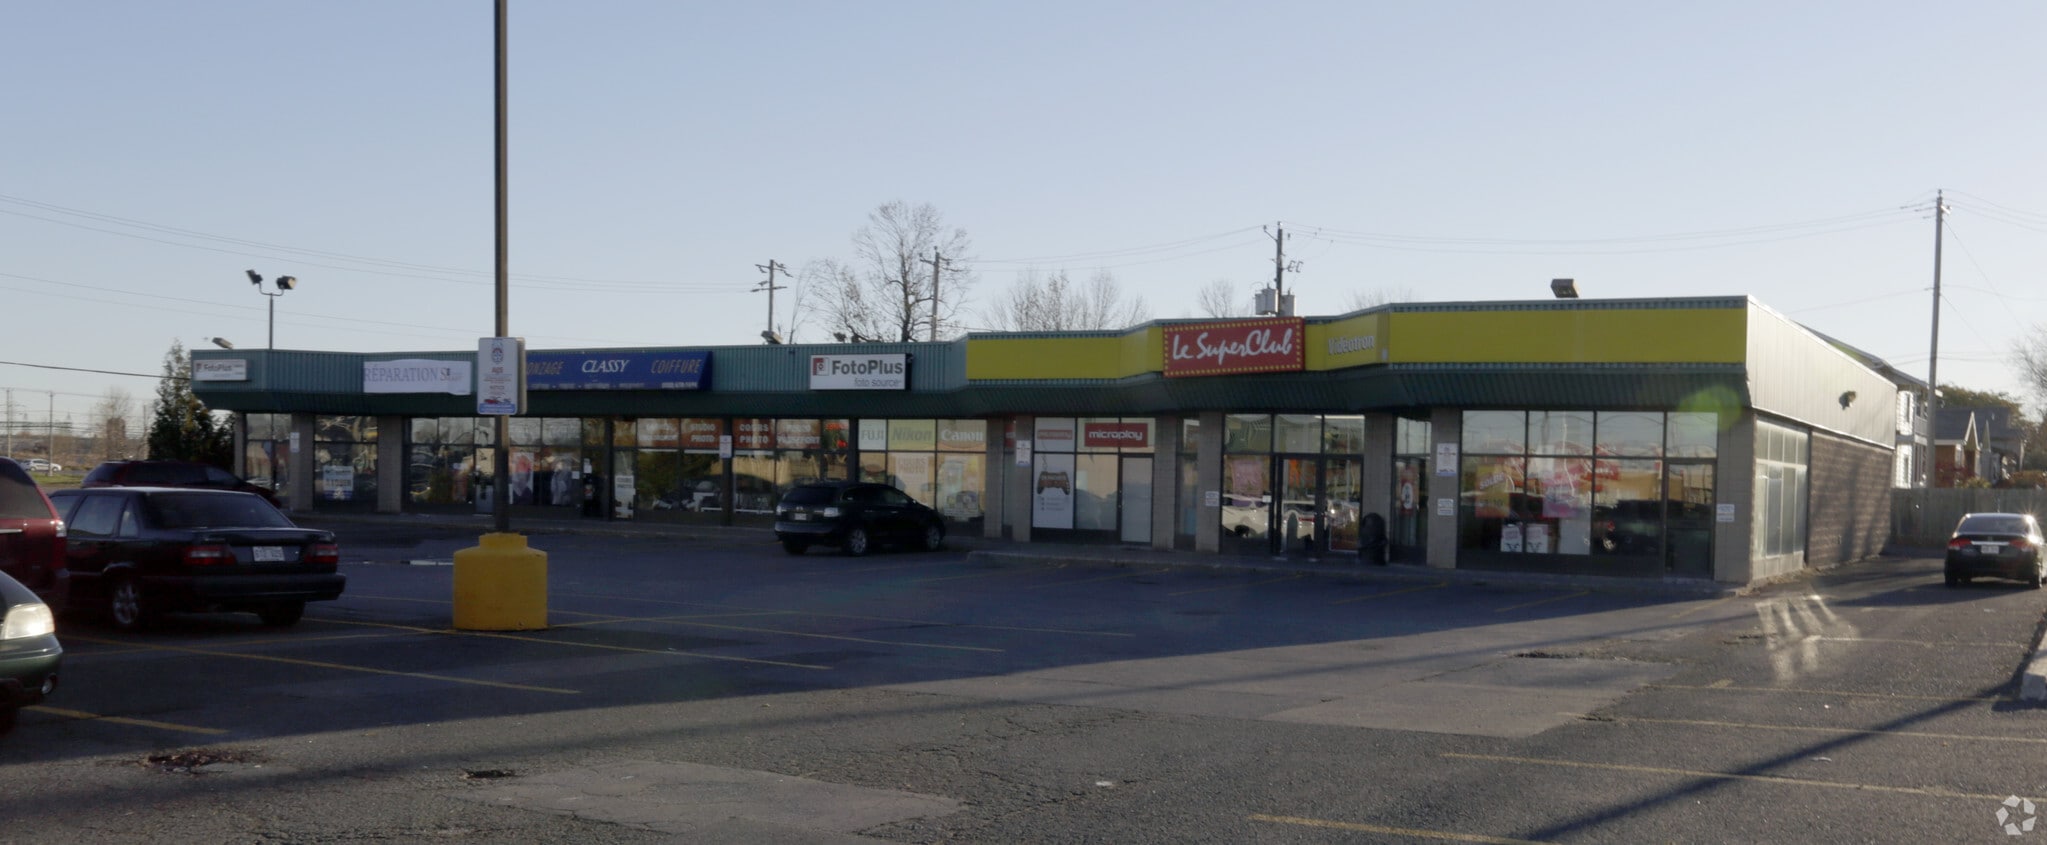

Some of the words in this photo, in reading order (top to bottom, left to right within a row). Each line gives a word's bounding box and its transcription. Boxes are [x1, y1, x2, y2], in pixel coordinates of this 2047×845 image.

[1173, 334, 1193, 360] Le
[1196, 327, 1293, 365] SuperClub
[526, 361, 564, 375] ONZAGE
[581, 360, 630, 373] CLASSY
[651, 359, 702, 374] COIFFURE
[832, 360, 903, 375] FotoPlus
[364, 365, 438, 383] RÉPARATION
[854, 377, 870, 387] foto
[739, 435, 769, 443] PHOTO
[893, 426, 932, 441] Nikon
[941, 428, 983, 442] Canon
[1088, 430, 1143, 441] microplay
